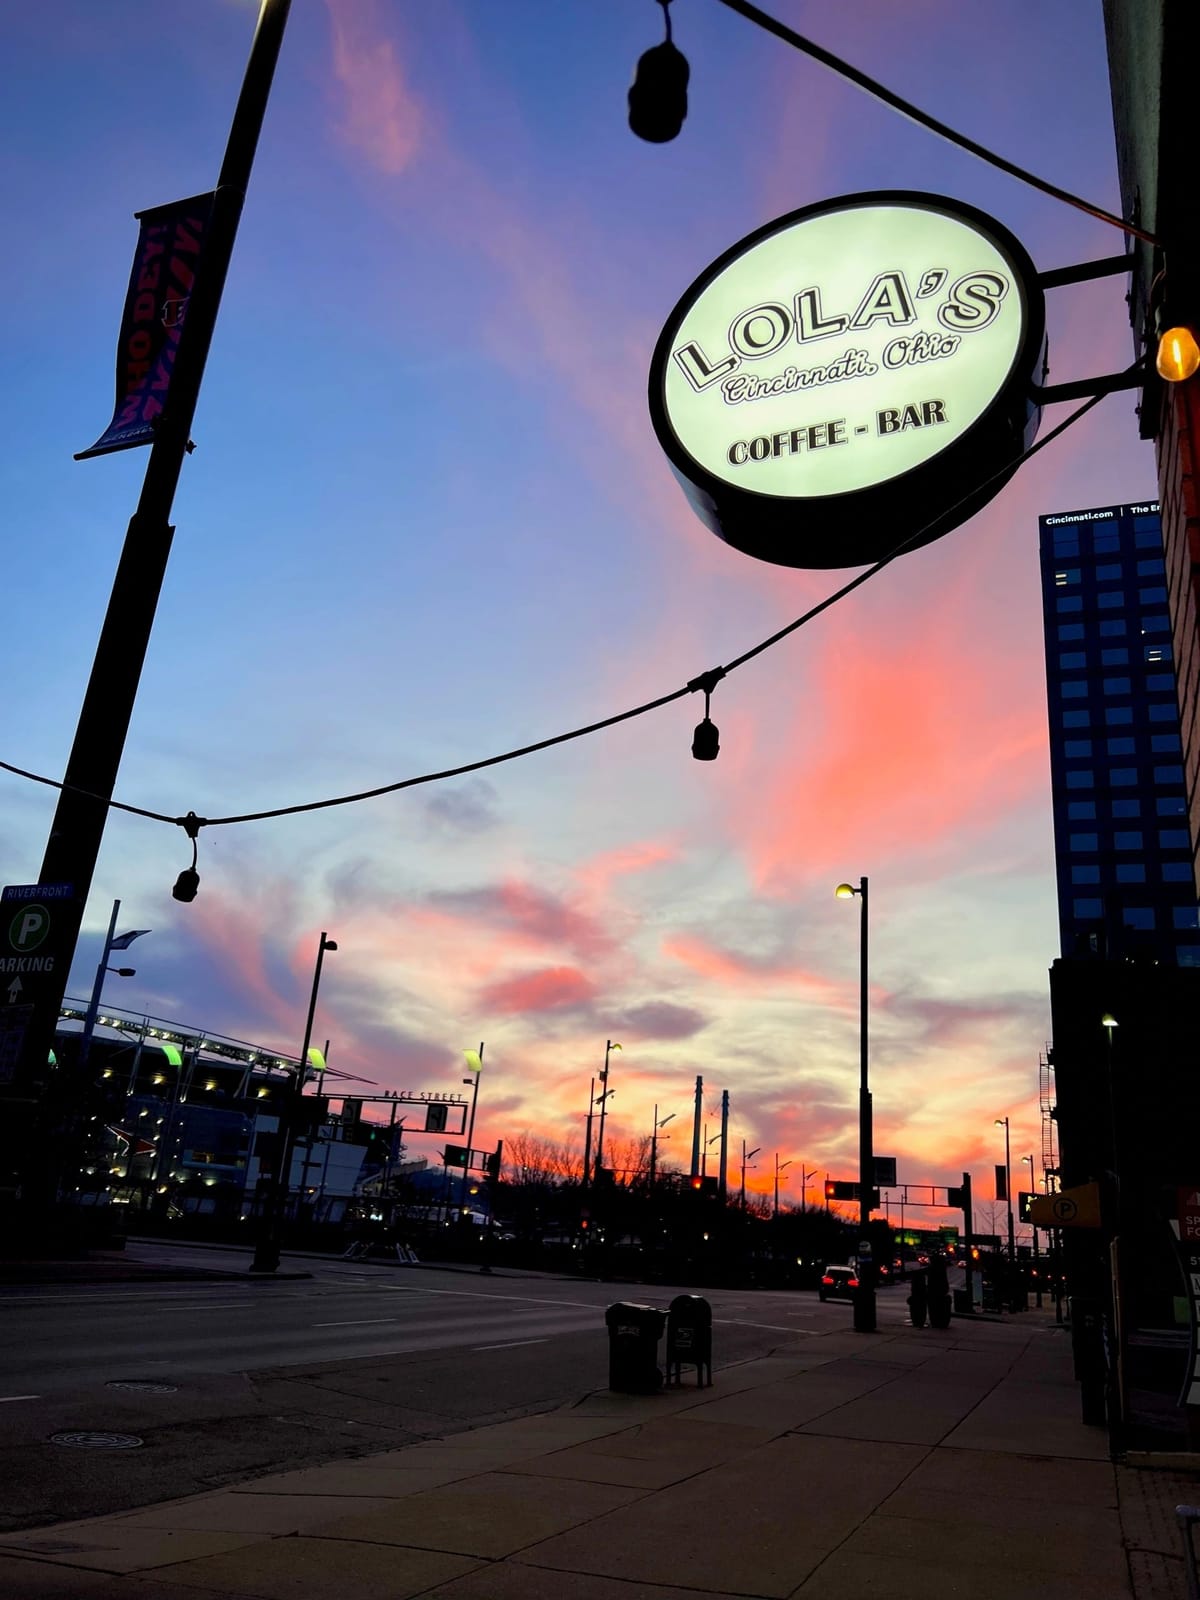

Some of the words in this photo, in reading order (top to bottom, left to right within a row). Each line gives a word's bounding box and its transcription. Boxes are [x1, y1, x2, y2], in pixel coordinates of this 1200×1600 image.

[673, 269, 1009, 393] LOLA'S
[883, 330, 961, 369] Ohio
[727, 418, 848, 466] COFFEE
[875, 399, 948, 437] BAR
[1045, 511, 1113, 525] Cincinnati.com
[1130, 505, 1149, 514] The
[7, 886, 69, 898] RIVERFRONT
[385, 1090, 413, 1099] RACE
[420, 1092, 463, 1101] STREET
